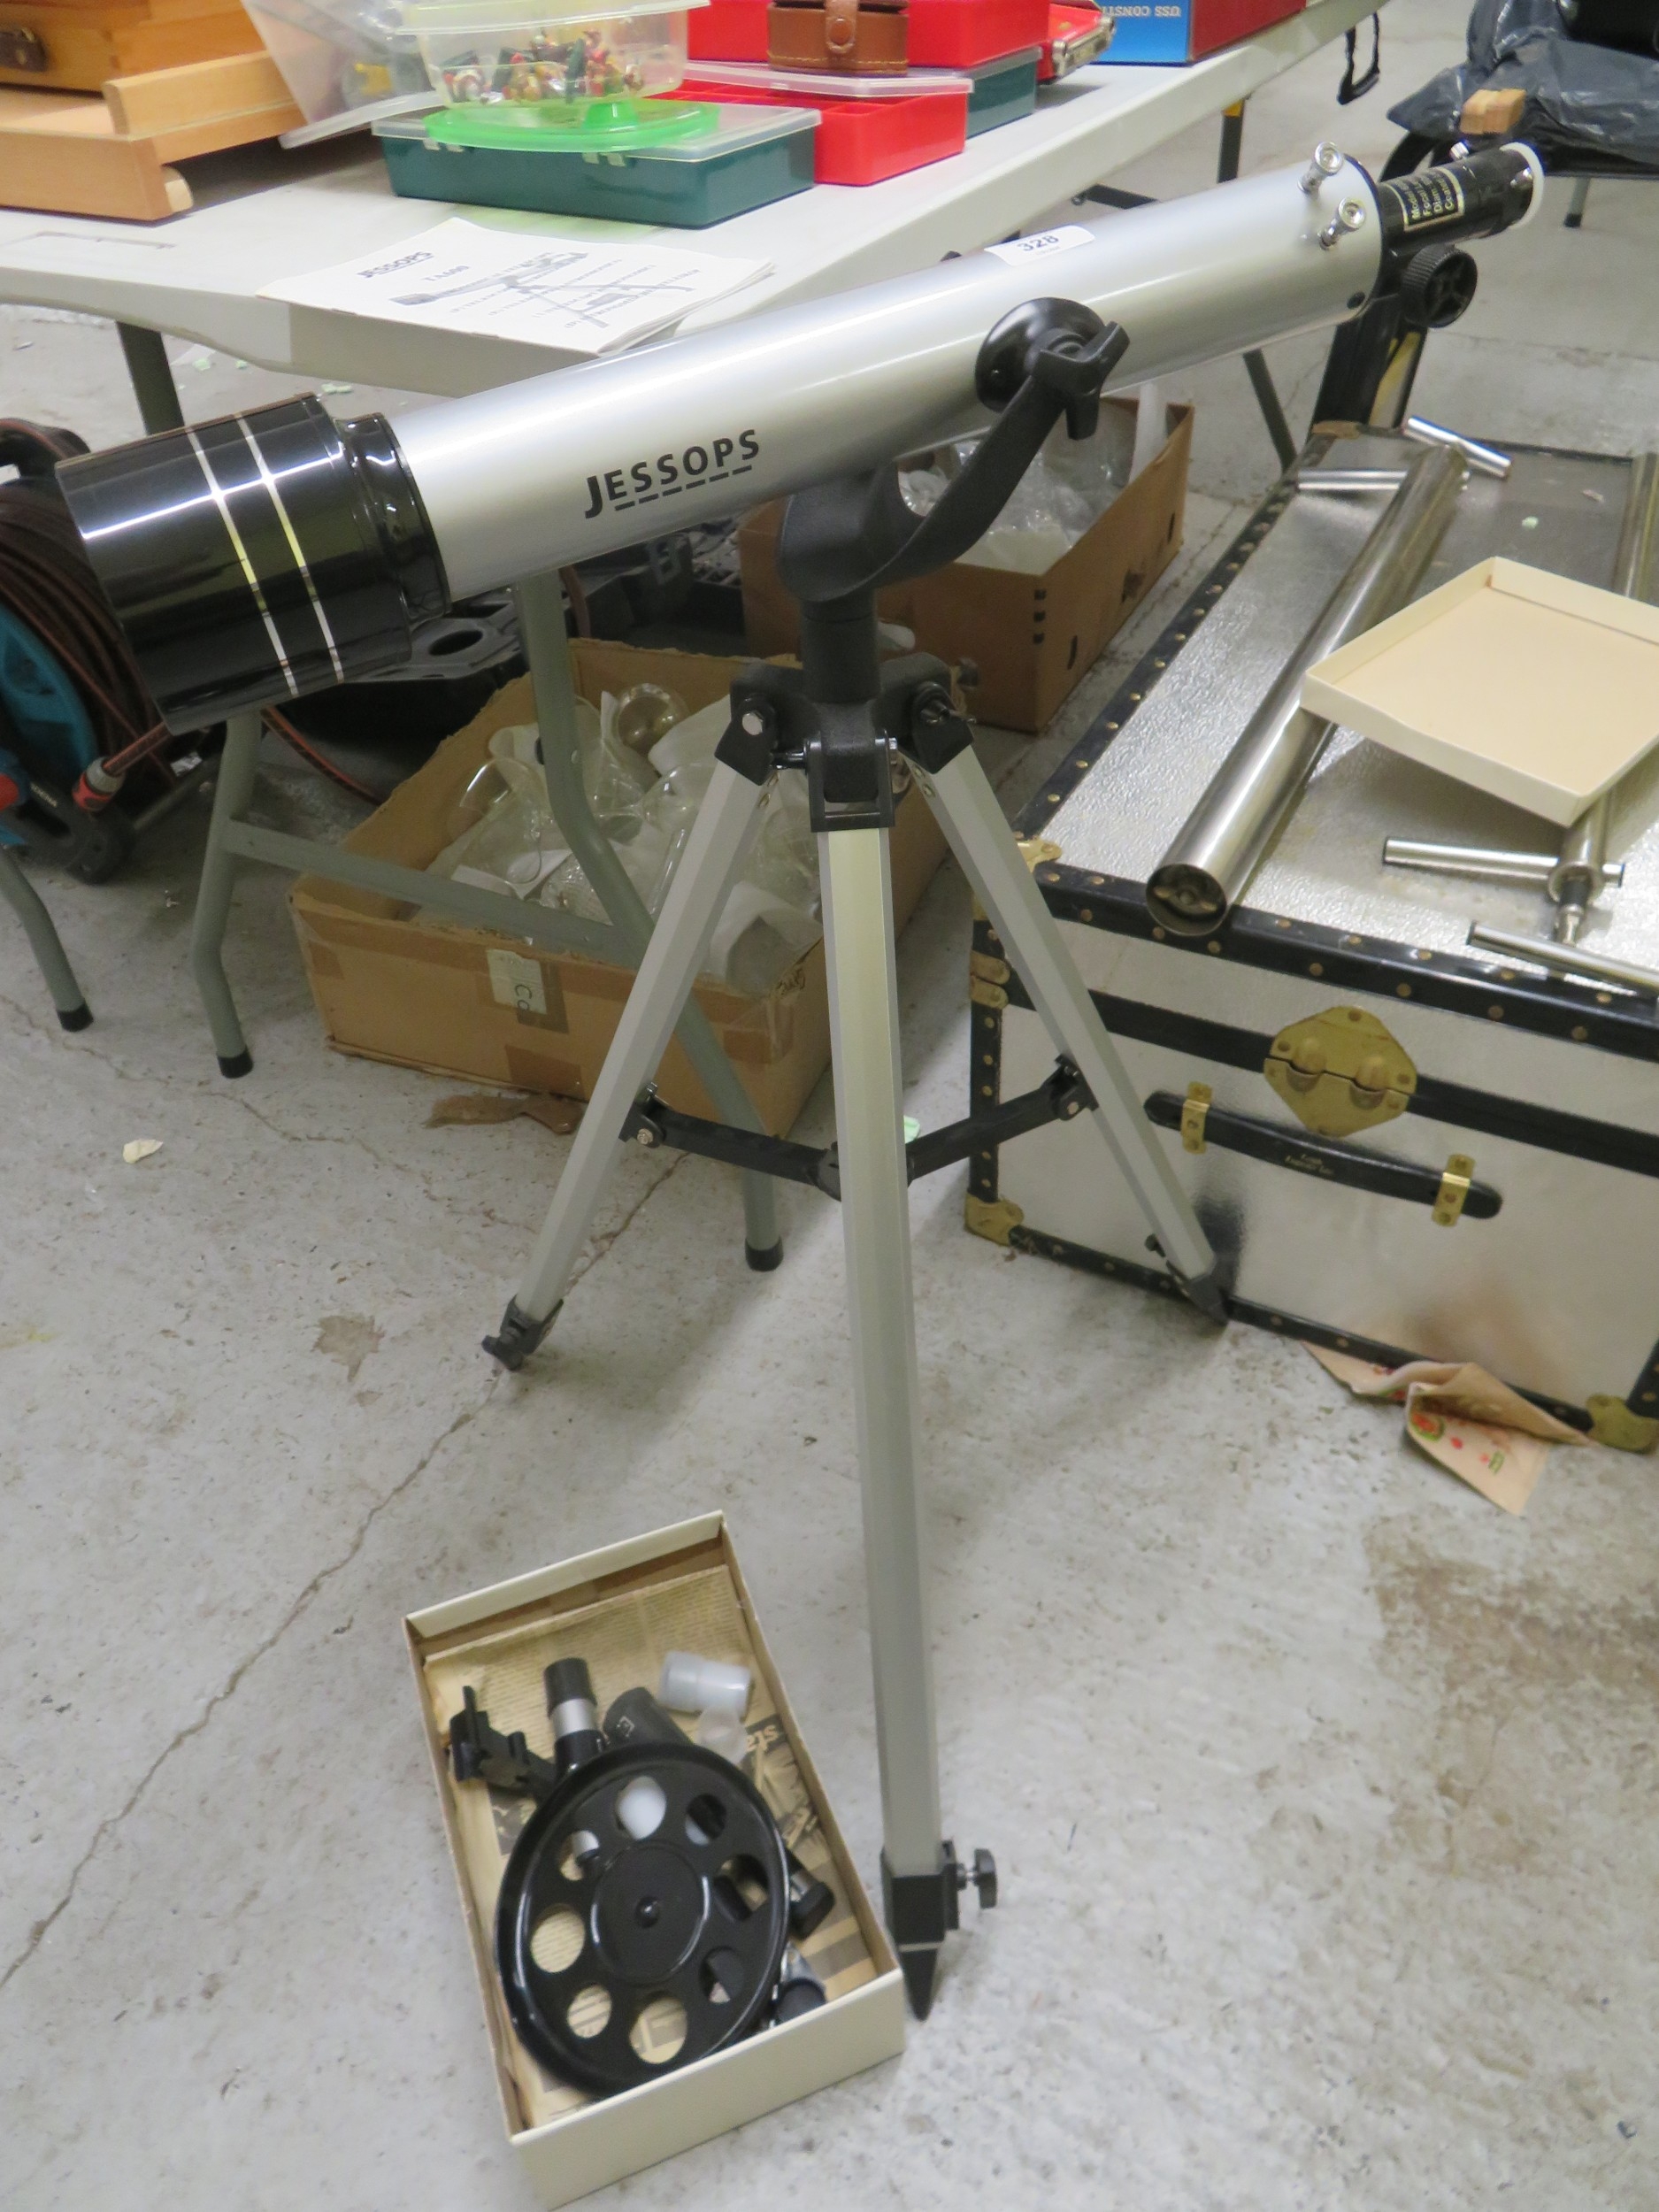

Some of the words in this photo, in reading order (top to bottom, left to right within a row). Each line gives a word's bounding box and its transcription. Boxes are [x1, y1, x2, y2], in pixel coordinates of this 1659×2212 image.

[1018, 234, 1059, 251] 328
[357, 251, 432, 278] JESSOPS
[585, 429, 759, 518] JESSOPS
